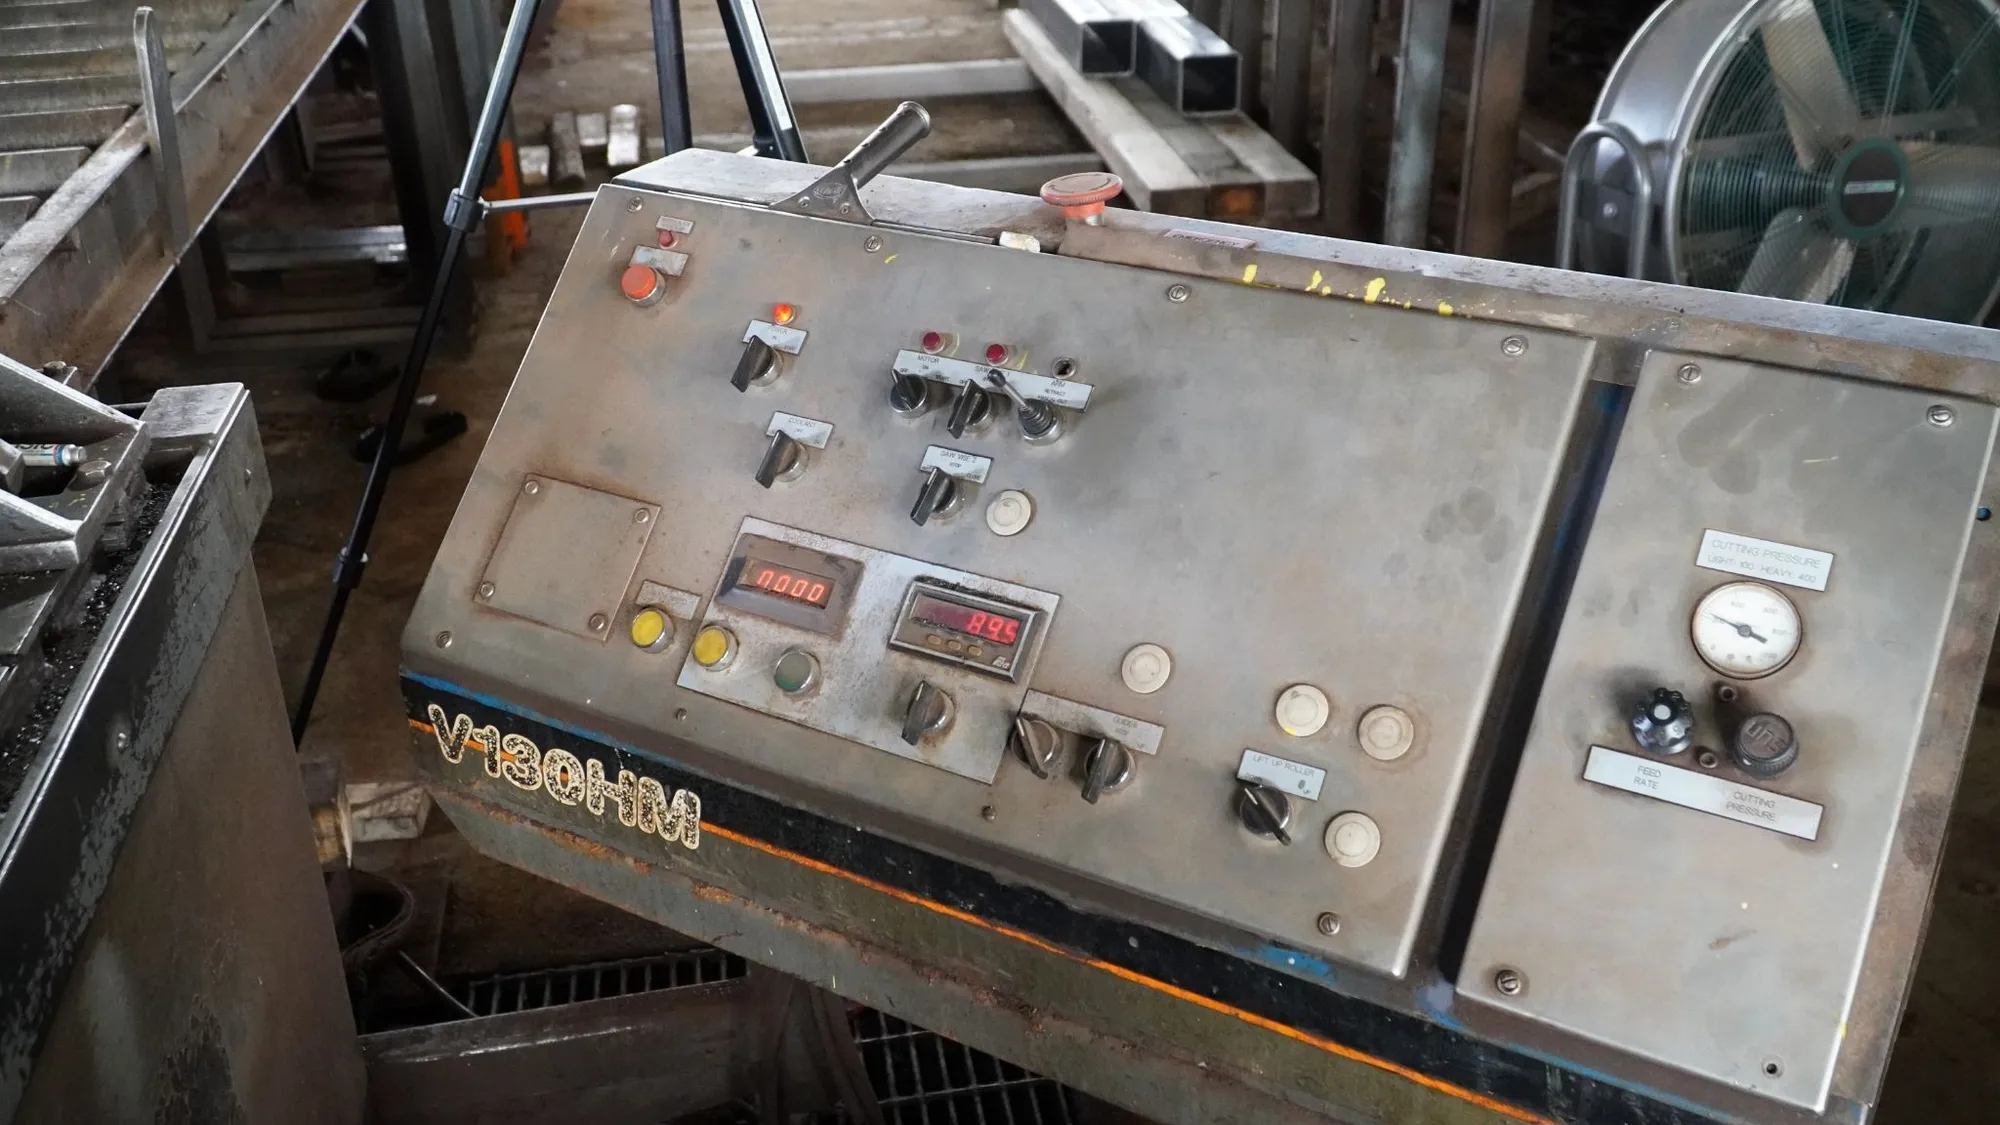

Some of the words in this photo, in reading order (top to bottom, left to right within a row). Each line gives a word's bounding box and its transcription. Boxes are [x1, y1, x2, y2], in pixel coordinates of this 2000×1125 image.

[917, 355, 940, 364] MOTOR
[788, 417, 817, 429] COOLANT
[941, 450, 956, 458] SAW
[1712, 539, 1760, 557] CUTTING
[1762, 549, 1821, 569] PRESSURE
[1797, 573, 1817, 584] 400
[966, 611, 1021, 645] 895
[1252, 754, 1269, 765] LIFT
[1284, 763, 1316, 778] ROLLER
[1636, 764, 1662, 779] FEED
[427, 703, 702, 851] V130HM
[1632, 776, 1659, 791] RATE
[1732, 790, 1777, 809] CUTTING
[1725, 803, 1777, 823] PRESSURE
